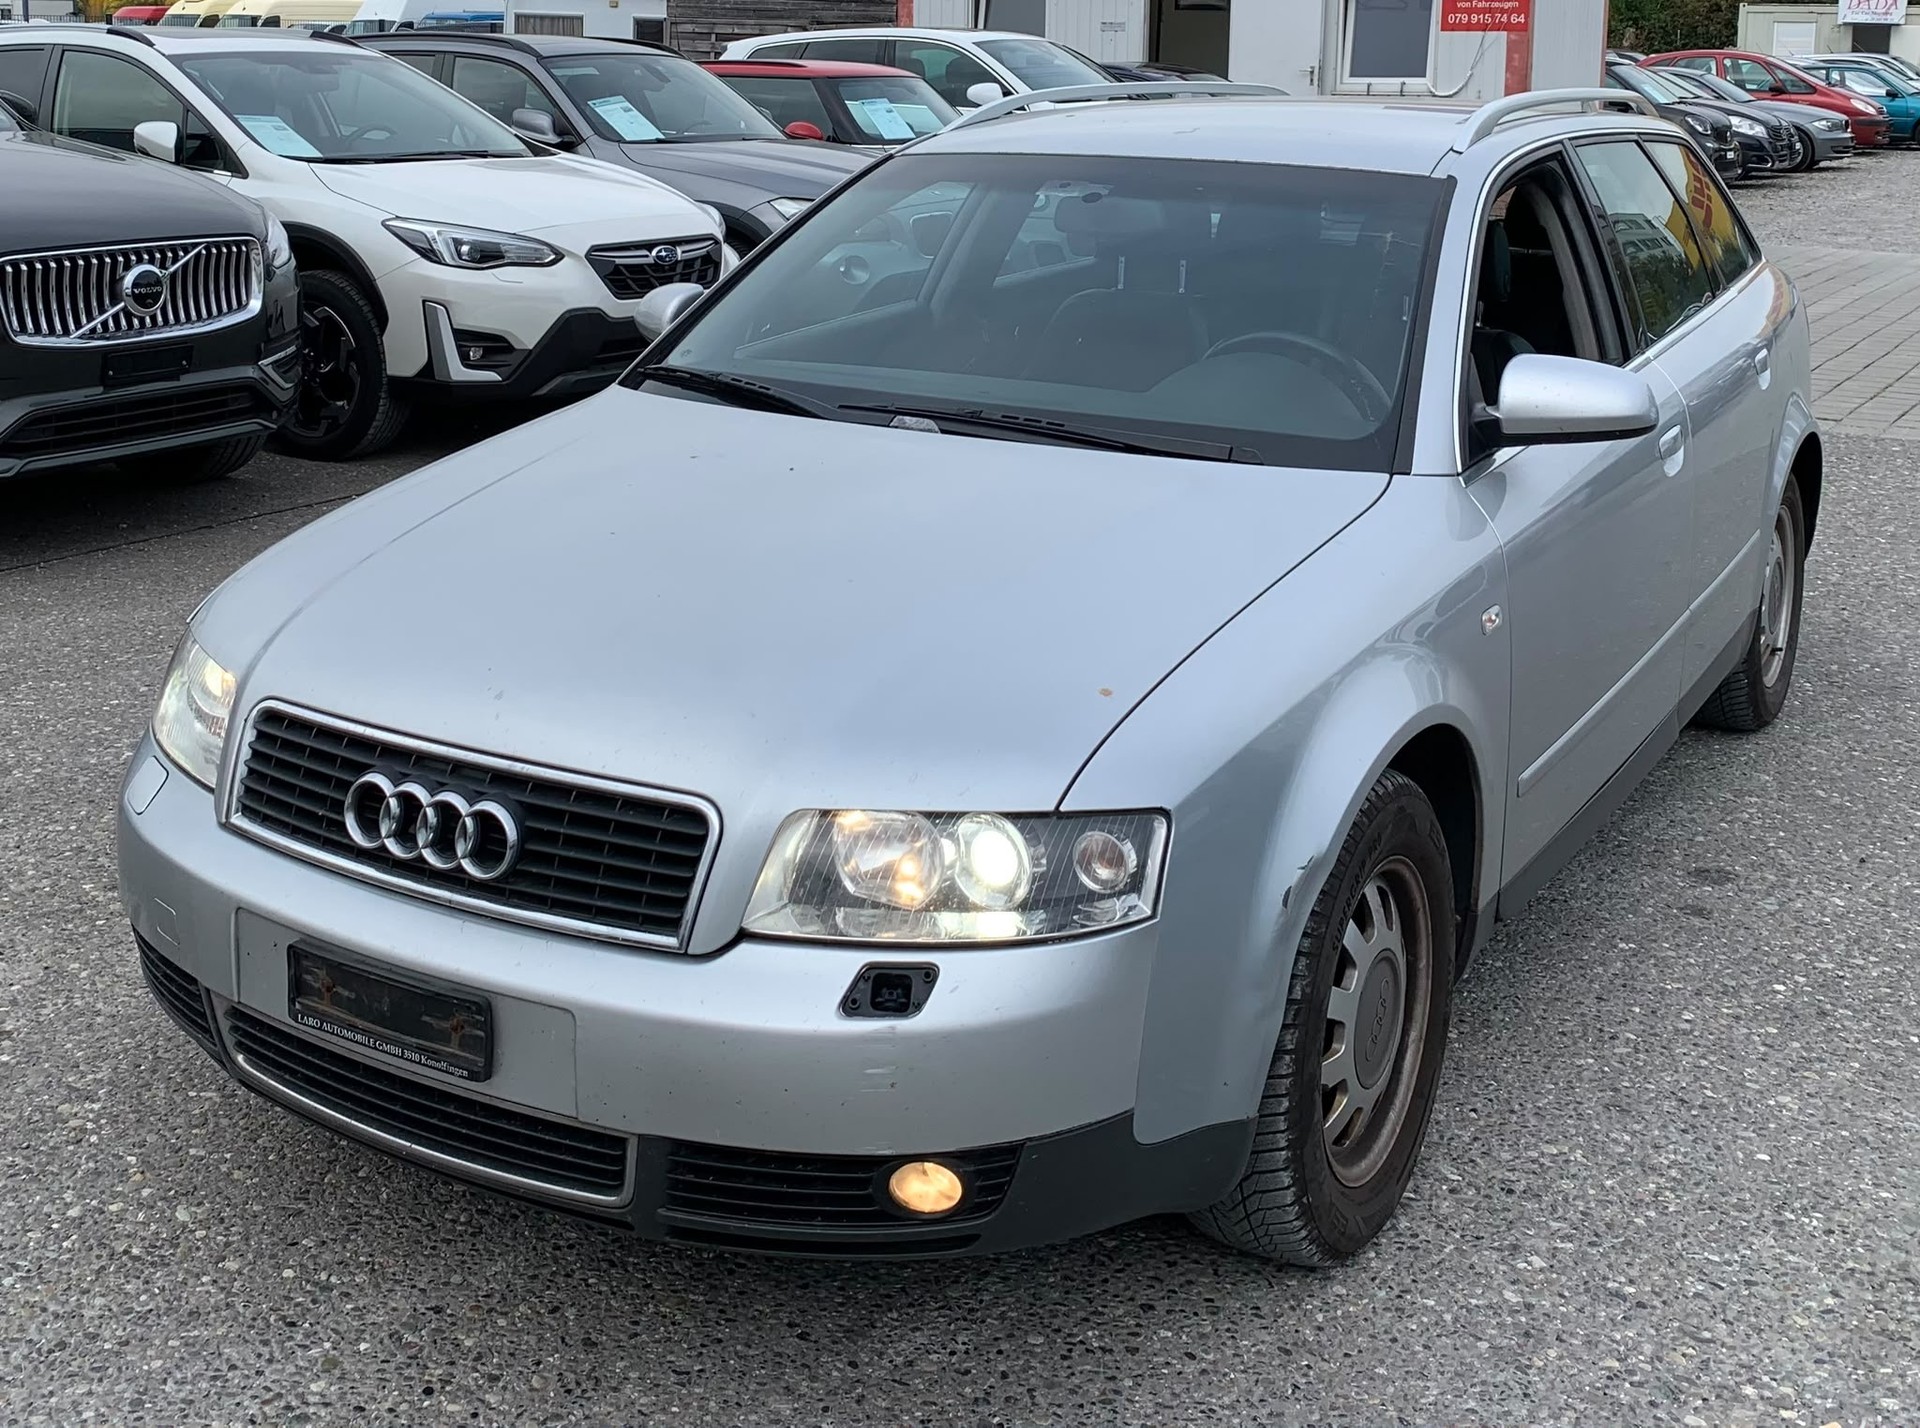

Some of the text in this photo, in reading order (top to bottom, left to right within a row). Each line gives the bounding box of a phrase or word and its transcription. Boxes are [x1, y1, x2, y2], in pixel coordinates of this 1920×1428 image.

[1472, 0, 1519, 9] Fahrzeugen
[1448, 13, 1525, 24] 079 915 74 64
[132, 286, 163, 294] VOLVO
[298, 1013, 469, 1077] LARO AUTOMOBILE GMBH 3510 Konolfingen
